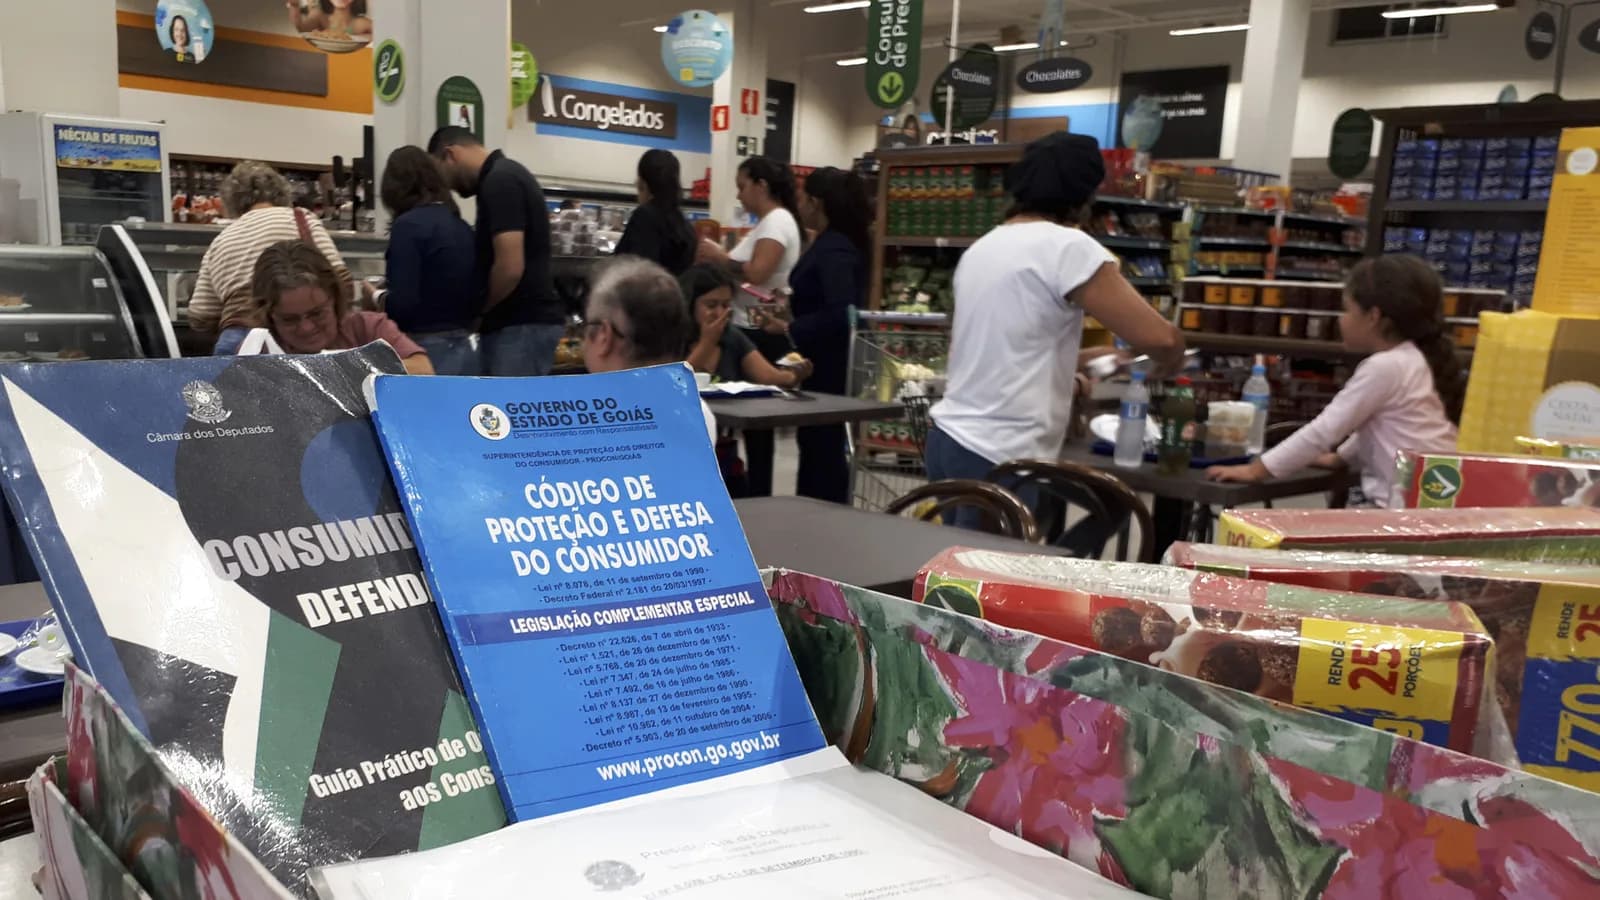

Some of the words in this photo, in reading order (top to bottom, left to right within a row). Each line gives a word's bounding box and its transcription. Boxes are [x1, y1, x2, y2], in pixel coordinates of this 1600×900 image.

[890, 42, 908, 68] de
[1026, 68, 1082, 84] Chocolates
[561, 94, 664, 130] Congelados
[58, 128, 99, 143] NÉCTAR
[102, 132, 116, 144] DE
[120, 134, 156, 146] FRUTAS
[505, 400, 588, 416] GOVERNO
[592, 397, 618, 410] DO
[510, 412, 572, 429] ESTADO
[578, 411, 599, 424] DE
[604, 405, 654, 422] GOIÁS
[146, 430, 192, 444] Câmara
[194, 427, 214, 439] dos
[216, 424, 274, 440] Deputados
[528, 458, 580, 468] CONSUMIDOR
[562, 449, 572, 457] DE
[574, 446, 614, 457] PROTEÇÃO
[616, 444, 631, 452] AOS
[632, 442, 666, 450] DIREITOS
[524, 475, 620, 510] CÓDIGO
[624, 475, 656, 500] DE
[484, 506, 609, 547] PROTEÇÃO
[612, 509, 630, 534] E
[632, 501, 714, 533] DEFESA
[511, 549, 550, 577] DO
[556, 532, 713, 574] CONSUMIDOR
[538, 584, 552, 592] Lei
[594, 579, 604, 587] de
[607, 577, 616, 585] 11
[618, 576, 629, 584] de
[631, 572, 671, 583] setembro
[672, 570, 683, 578] de
[544, 593, 579, 604] Decreto
[580, 590, 614, 600] Federal
[626, 586, 648, 595] 2.181
[296, 571, 433, 628] DEFEND
[510, 610, 592, 634] LEGISLAÇÃO
[594, 600, 693, 625] COMPLEMENTAR
[697, 591, 755, 612] ESPECIAL
[1557, 602, 1575, 639] RENDE
[560, 640, 596, 652] Decreto
[642, 634, 652, 642] de
[661, 631, 672, 639] de
[674, 628, 692, 637] abril
[694, 626, 704, 634] de
[706, 623, 726, 632] 1933
[563, 656, 578, 664] Lei
[620, 648, 630, 657] de
[644, 646, 654, 654] de
[657, 640, 698, 652] dezembro
[700, 638, 710, 646] de
[712, 634, 730, 644] 1951
[568, 667, 582, 676] Lei
[624, 660, 634, 668] de
[636, 658, 646, 667] 20
[649, 657, 660, 665] de
[662, 652, 702, 664] dezembro
[716, 645, 735, 654] 1971
[583, 678, 598, 686] Lei
[639, 671, 650, 679] de
[651, 668, 662, 677] 24
[664, 667, 674, 676] de
[676, 664, 698, 675] julho
[699, 662, 710, 670] de
[1348, 642, 1401, 696] 25
[583, 704, 598, 712] Lei
[636, 696, 647, 704] de
[648, 694, 658, 702] 27
[662, 692, 672, 700] de
[674, 686, 716, 698] dezembro
[588, 690, 602, 698] Lei
[644, 682, 654, 690] de
[668, 679, 679, 687] de
[680, 676, 702, 686] julho
[588, 716, 604, 725] Lei
[645, 708, 656, 716] de
[658, 705, 668, 714] 13
[670, 704, 680, 712] de
[682, 698, 720, 710] fevereiro
[600, 728, 614, 736] Lei
[661, 718, 672, 726] de
[674, 716, 682, 724] 11
[685, 711, 718, 722] outubro
[720, 708, 730, 716] de
[731, 704, 751, 714] 2004
[586, 740, 622, 752] Decreto
[664, 730, 674, 738] de
[676, 727, 686, 736] 20
[688, 726, 699, 734] de
[700, 720, 740, 732] setembro
[741, 716, 752, 724] de
[309, 768, 364, 798] Guia
[360, 747, 438, 785] Prático
[437, 738, 466, 762] de
[597, 731, 781, 781] www.procon.go.gov.br
[400, 782, 442, 811] aos
[440, 765, 496, 798] Cons
